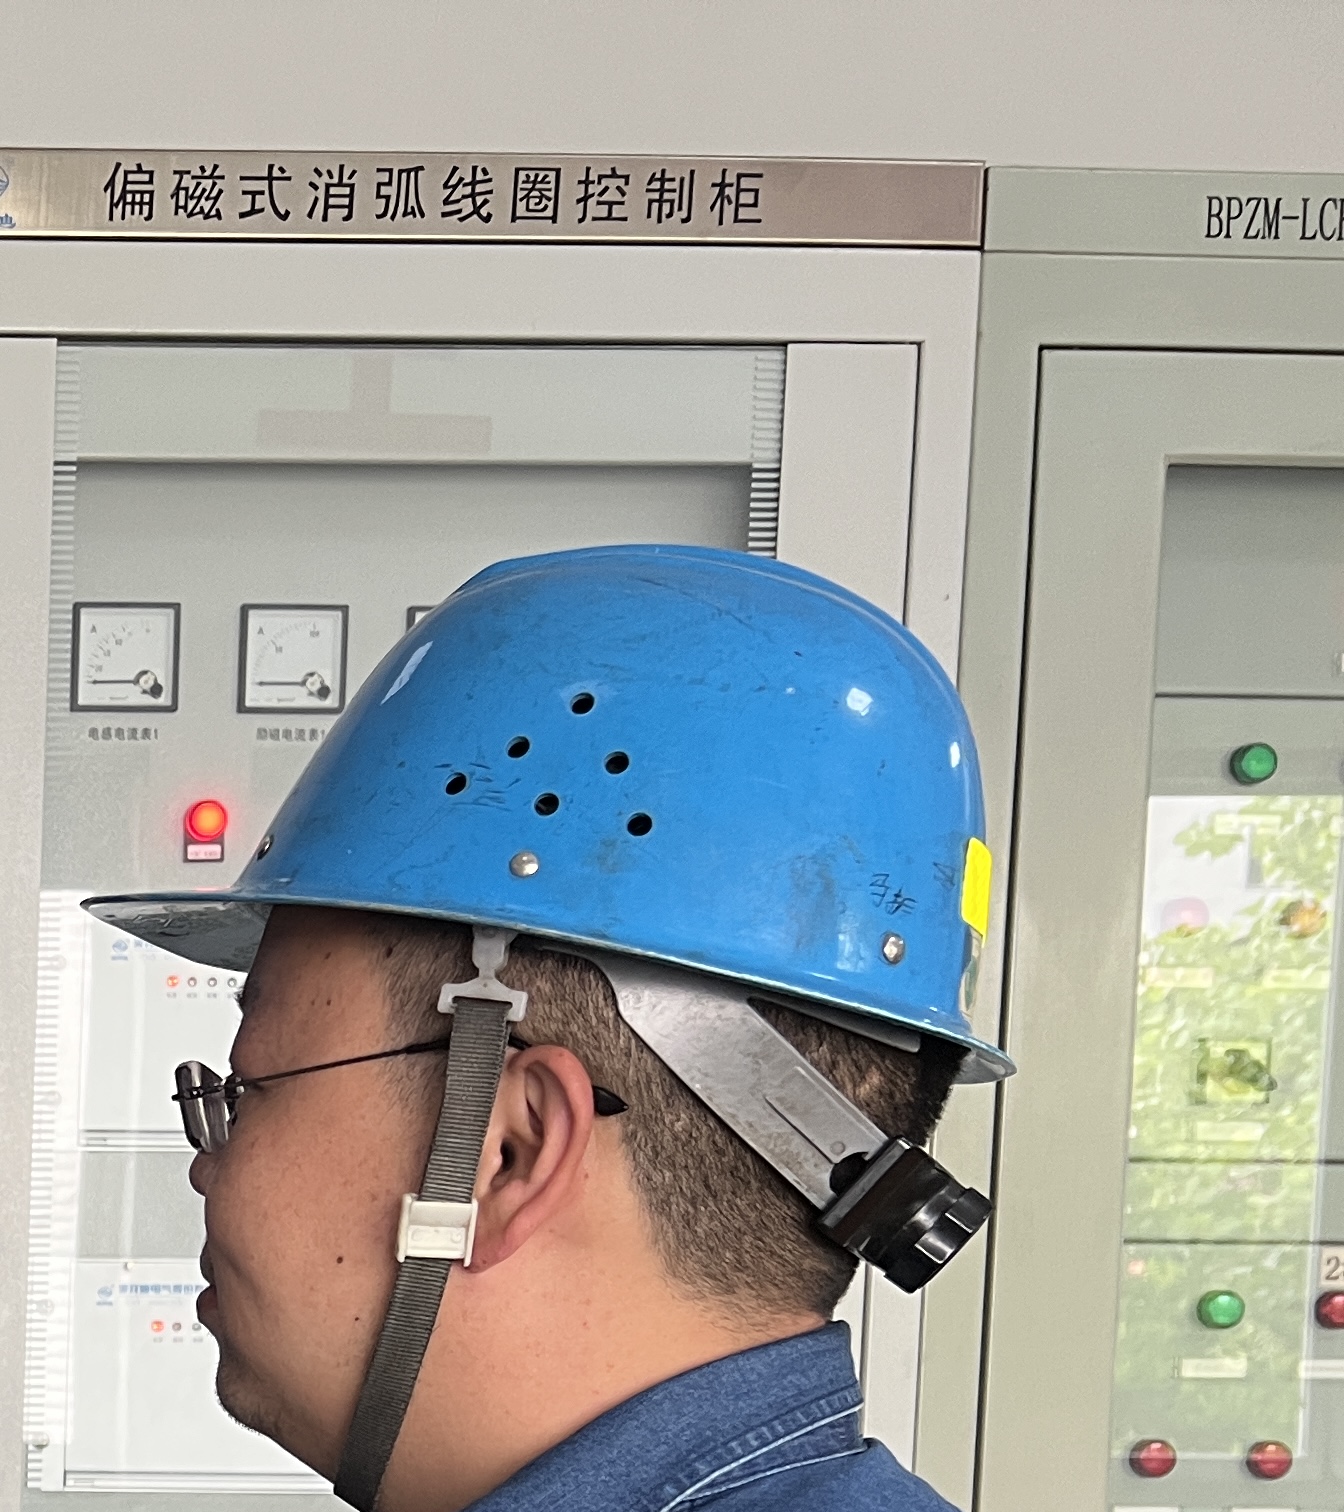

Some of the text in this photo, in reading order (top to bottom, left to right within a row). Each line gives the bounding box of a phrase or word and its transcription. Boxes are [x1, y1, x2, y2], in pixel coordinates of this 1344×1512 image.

[103, 161, 766, 227] 偏磁式消弧线圈控制柜
[1325, 1255, 1344, 1281] 2
